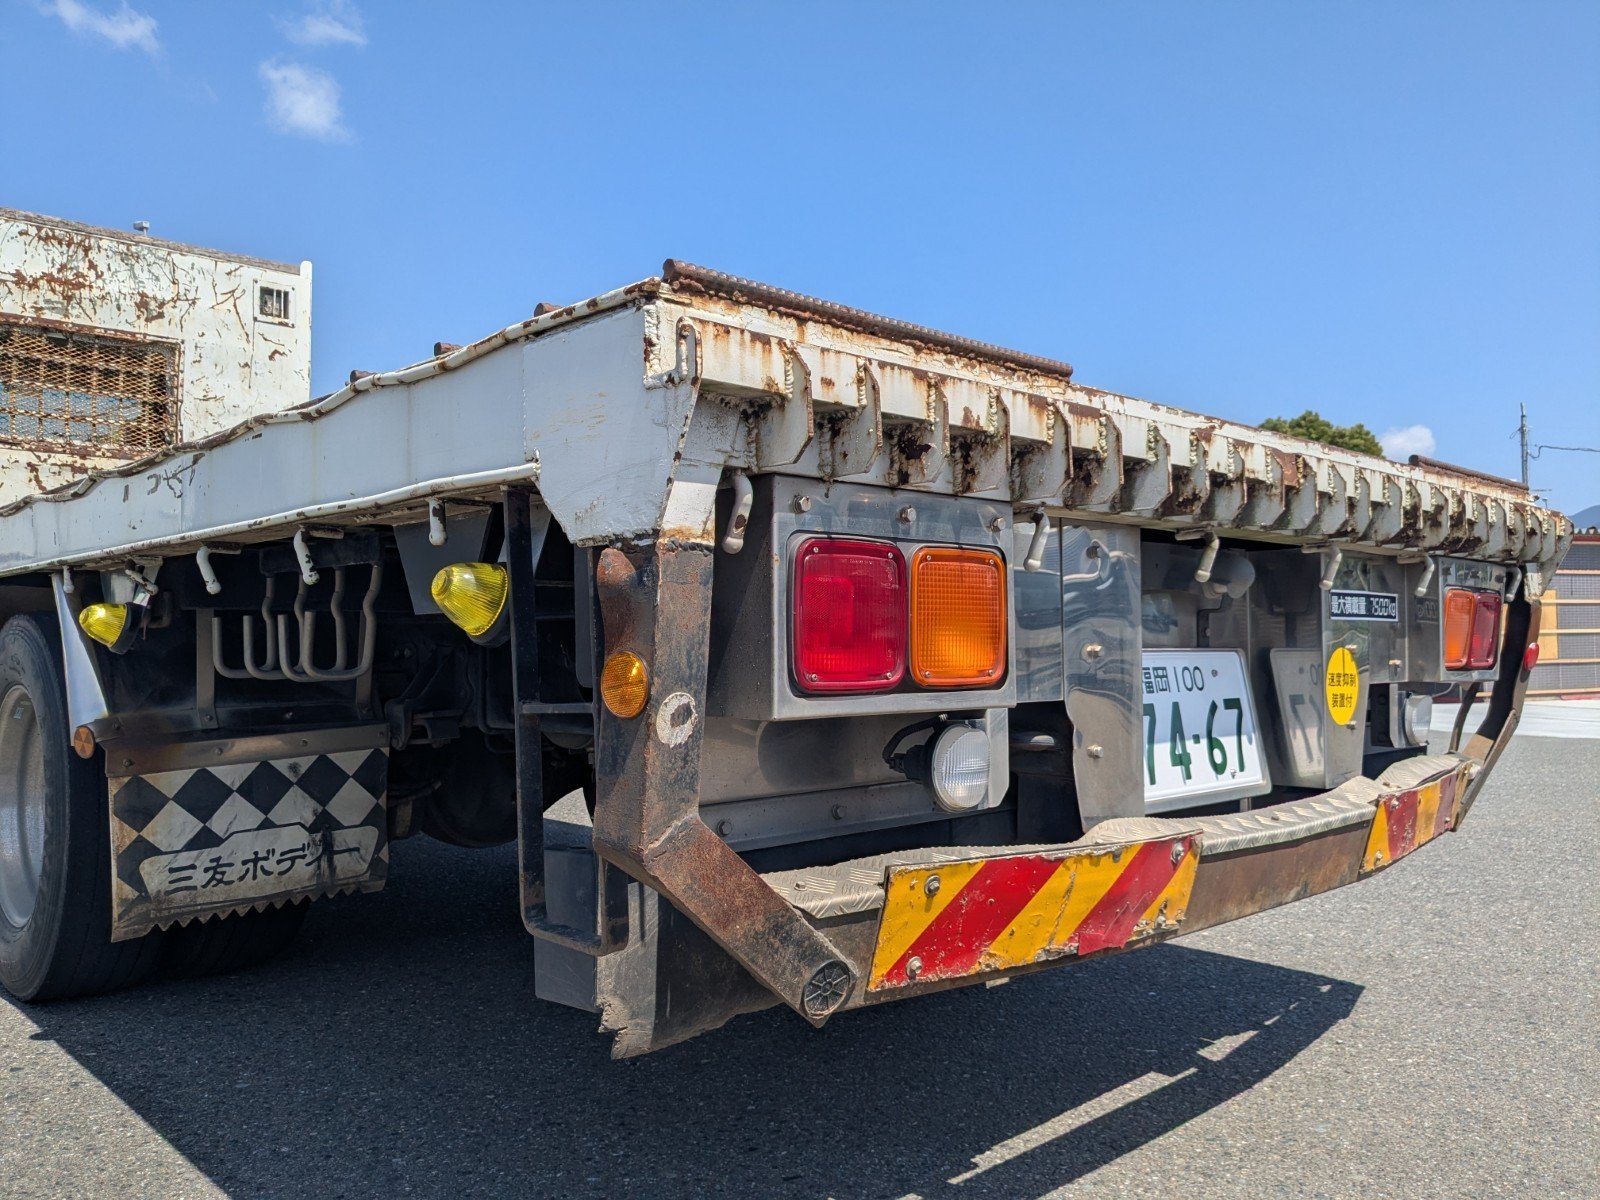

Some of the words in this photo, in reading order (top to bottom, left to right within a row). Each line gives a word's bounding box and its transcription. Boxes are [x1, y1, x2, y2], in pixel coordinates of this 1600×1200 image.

[1331, 595, 1366, 615] 最大積載量
[1328, 672, 1357, 688] 速度抑制
[1331, 693, 1353, 708] 装置付
[163, 842, 361, 897] 三友ボディー
